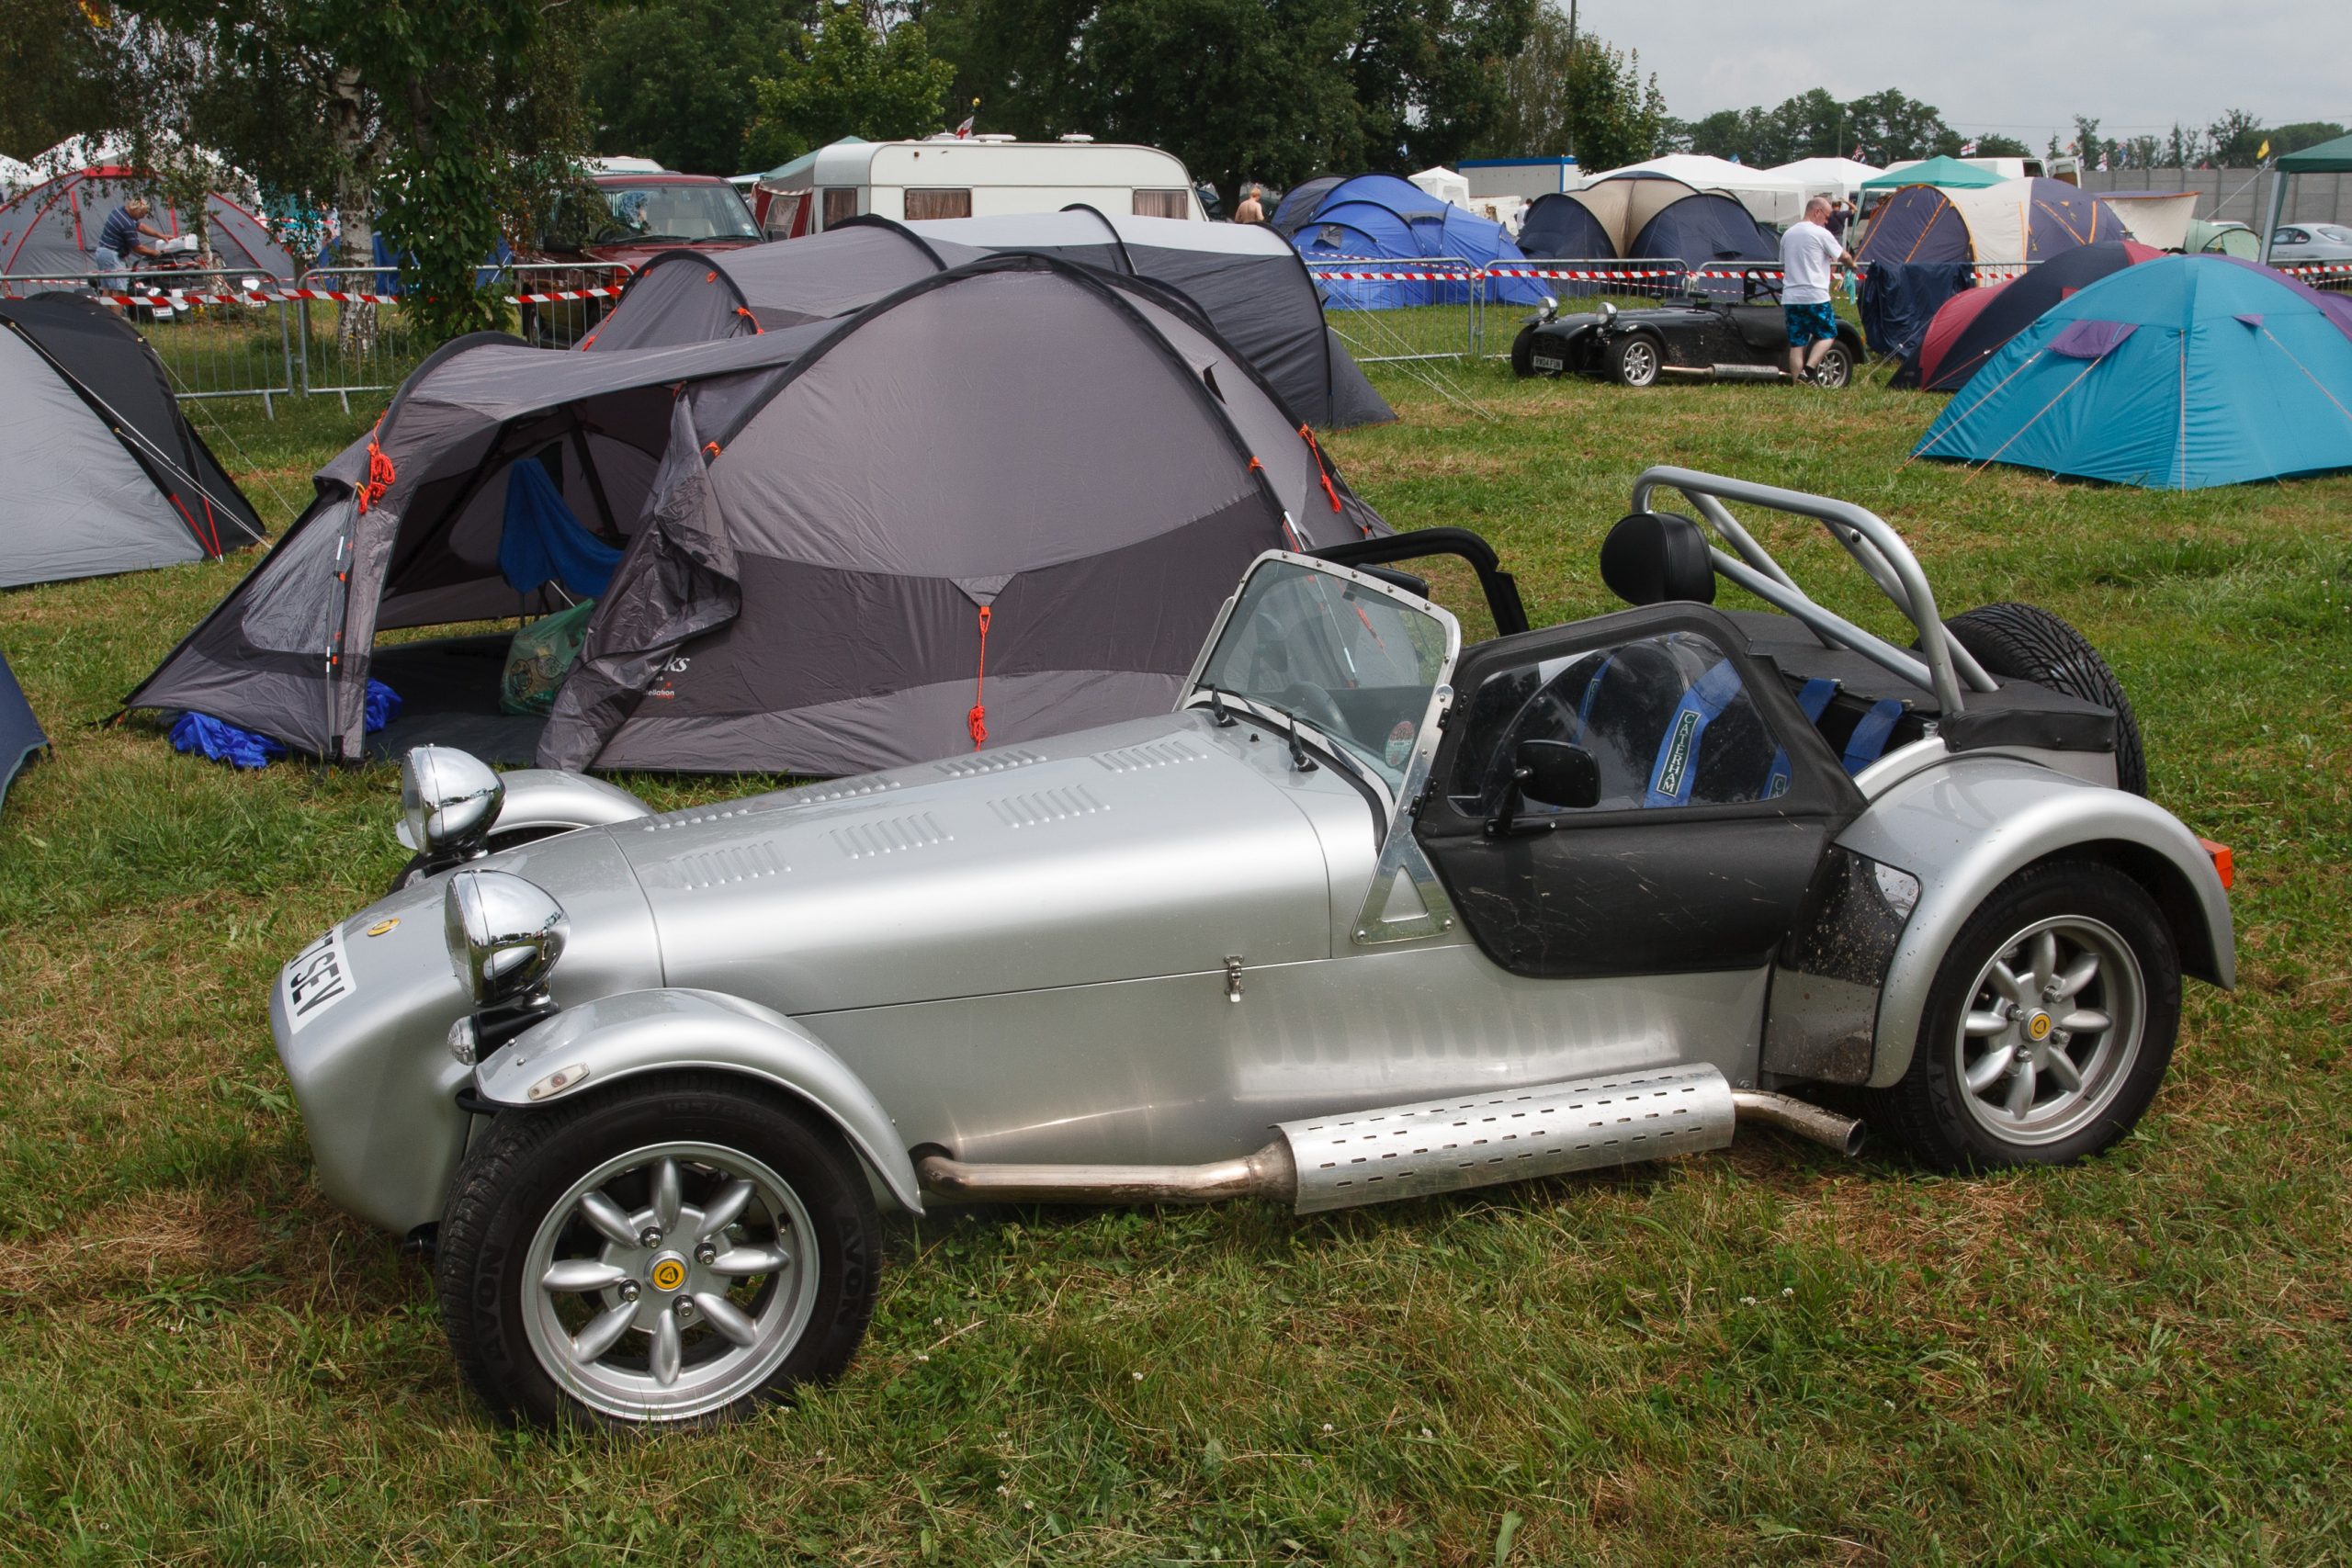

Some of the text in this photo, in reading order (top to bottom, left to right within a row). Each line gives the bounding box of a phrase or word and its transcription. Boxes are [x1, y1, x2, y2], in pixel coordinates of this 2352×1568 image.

[1662, 714, 1695, 793] CATERHAM
[290, 952, 345, 1017] SEV
[476, 1243, 507, 1361] AVON
[836, 1217, 864, 1325] AVON
